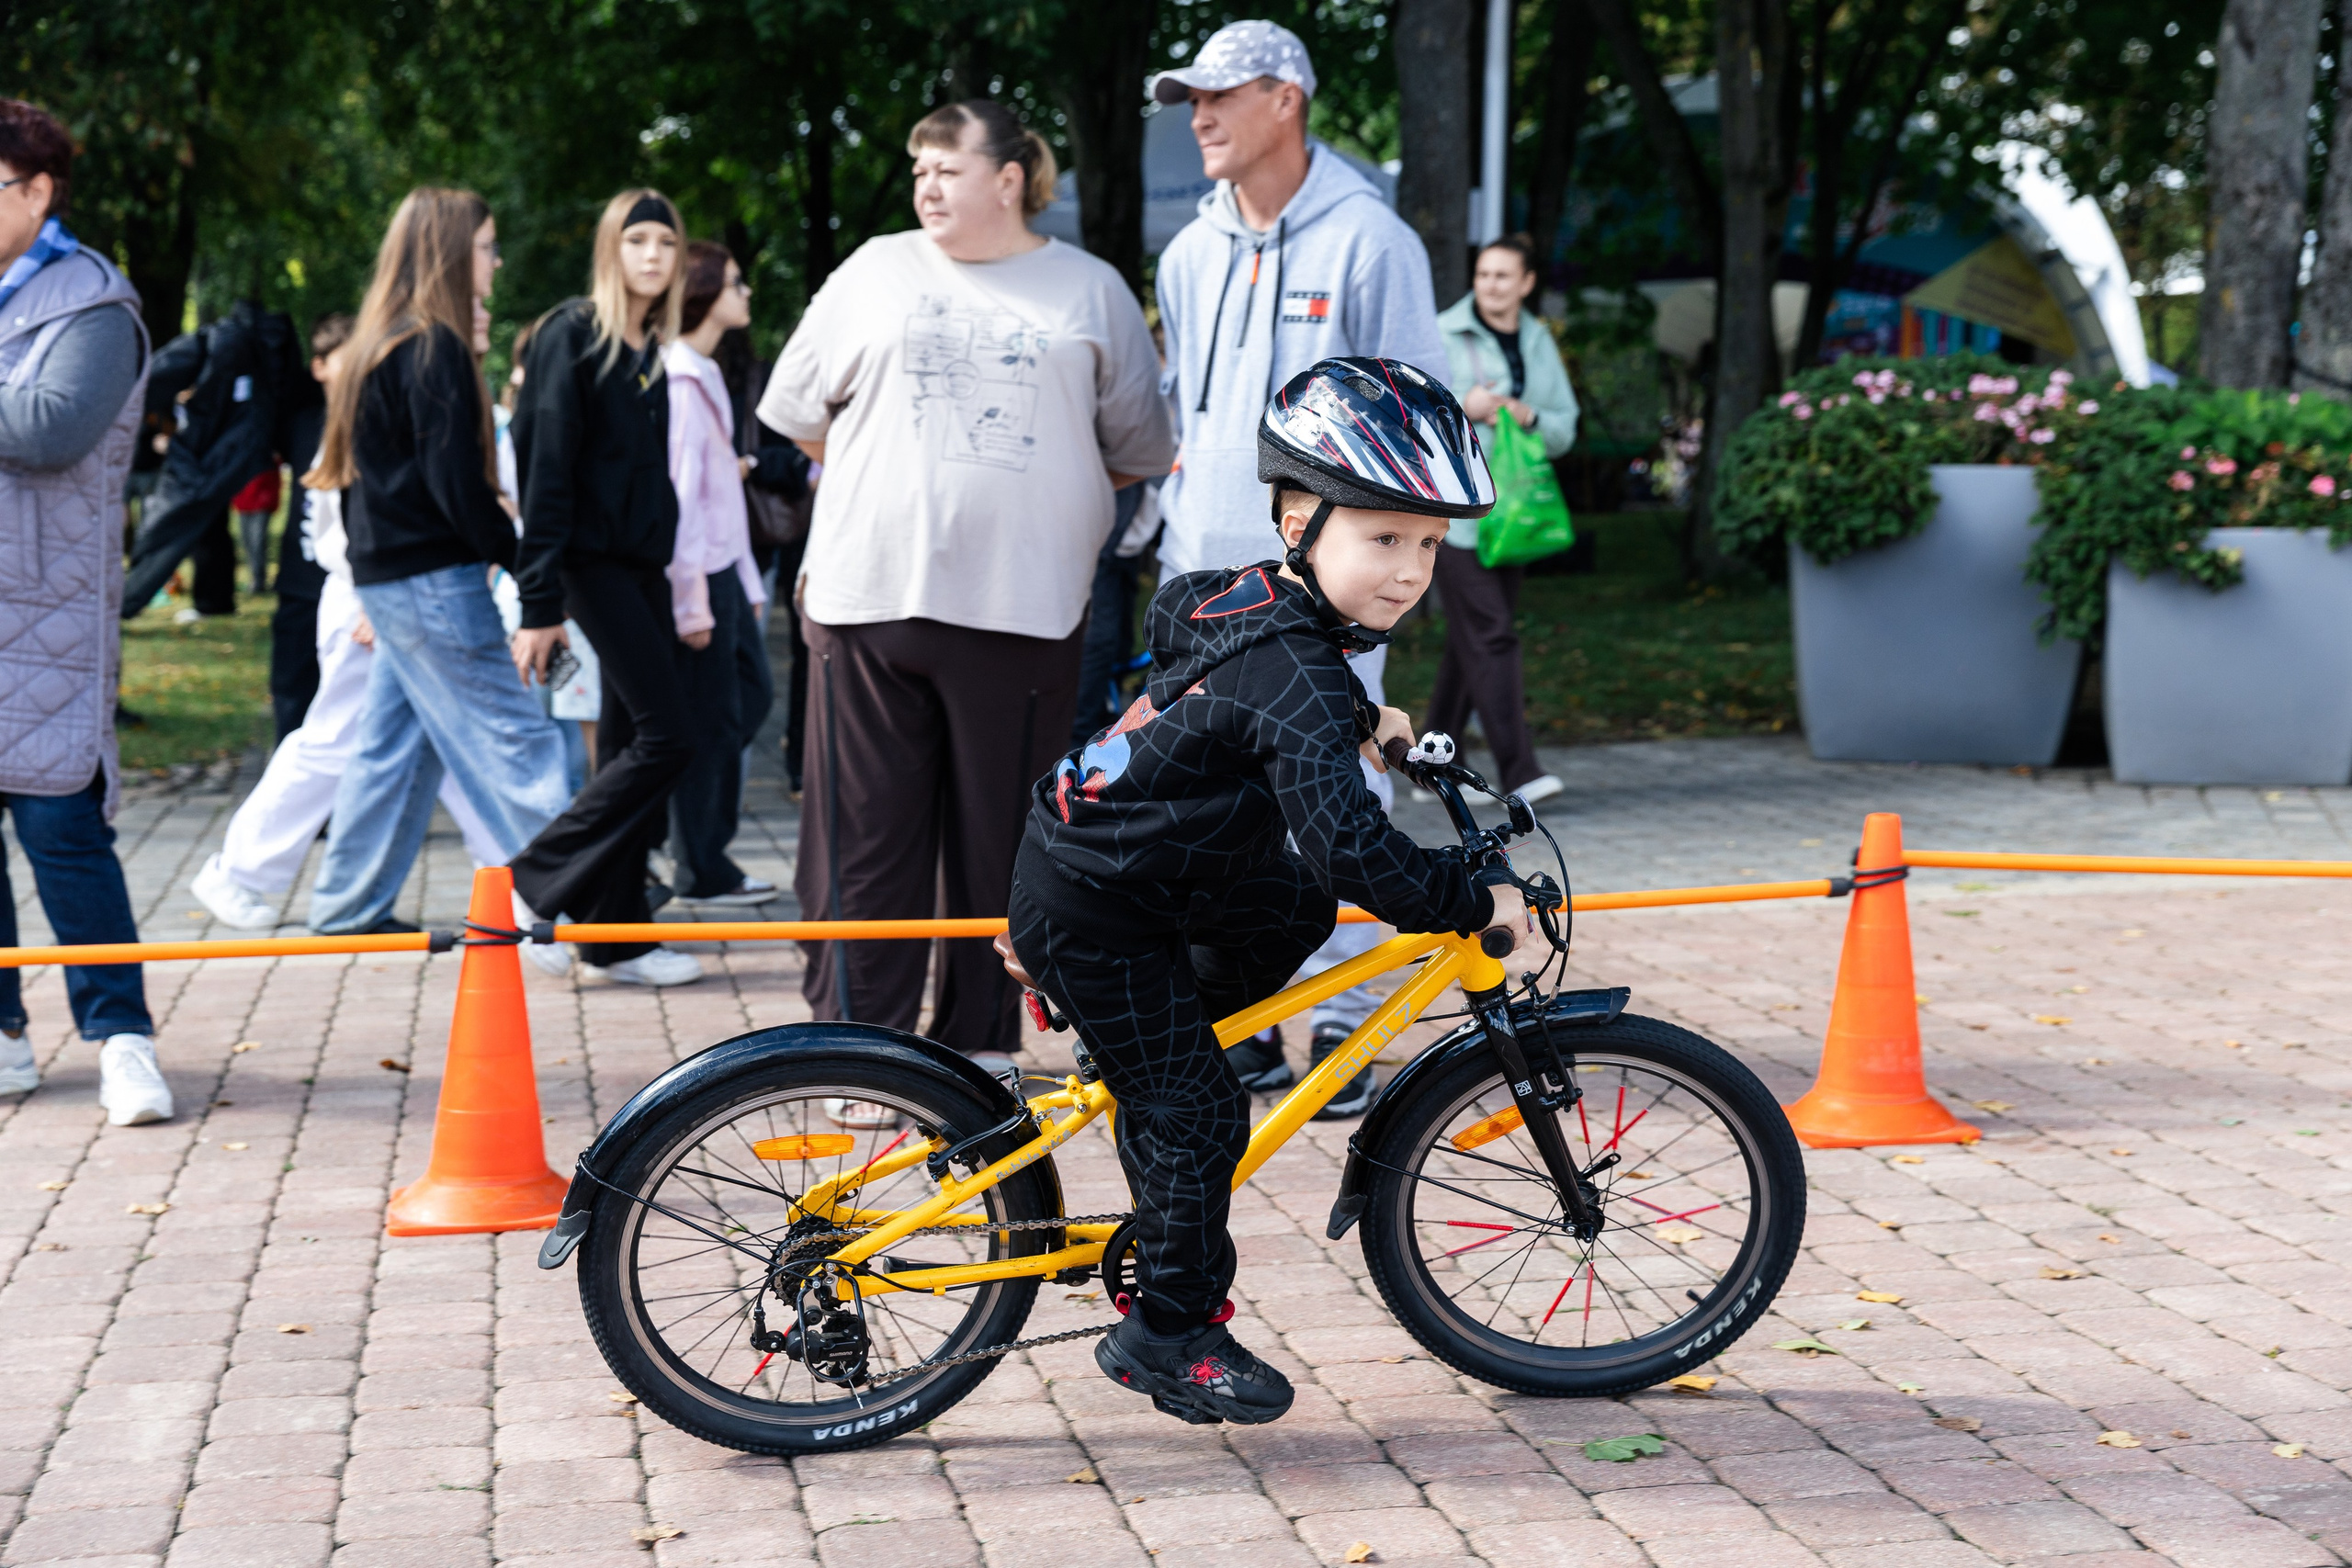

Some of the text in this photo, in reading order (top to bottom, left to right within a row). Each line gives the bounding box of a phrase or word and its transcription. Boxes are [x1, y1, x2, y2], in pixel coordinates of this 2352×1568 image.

[1335, 1002, 1419, 1082] SHULZ
[995, 1152, 1040, 1180] Bubble
[1673, 1276, 1762, 1359] KENDA
[812, 1398, 919, 1441] KENDA
